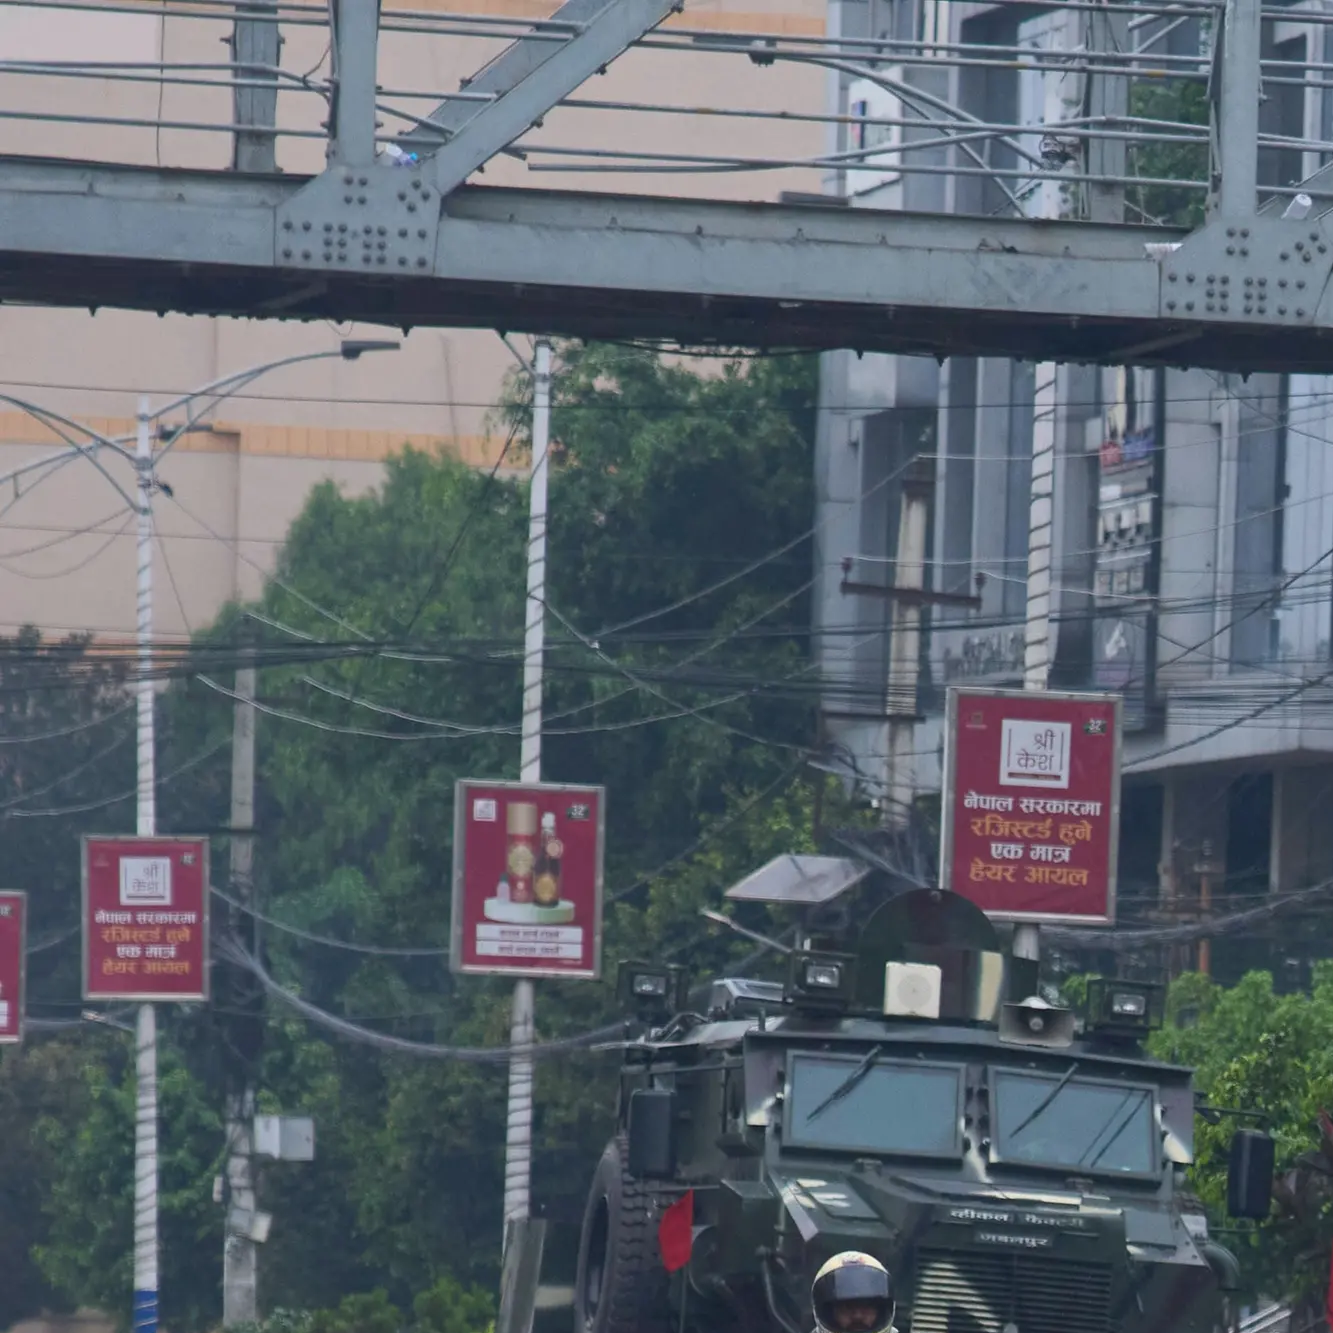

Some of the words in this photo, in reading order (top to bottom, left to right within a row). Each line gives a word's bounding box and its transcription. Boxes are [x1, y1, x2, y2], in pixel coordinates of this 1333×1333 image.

[964, 790, 1013, 812] नेपाल
[1019, 797, 1102, 816] सरकारमा
[990, 842, 1024, 860] एक
[969, 857, 1017, 883] हेयर
[1024, 866, 1089, 886] आयल
